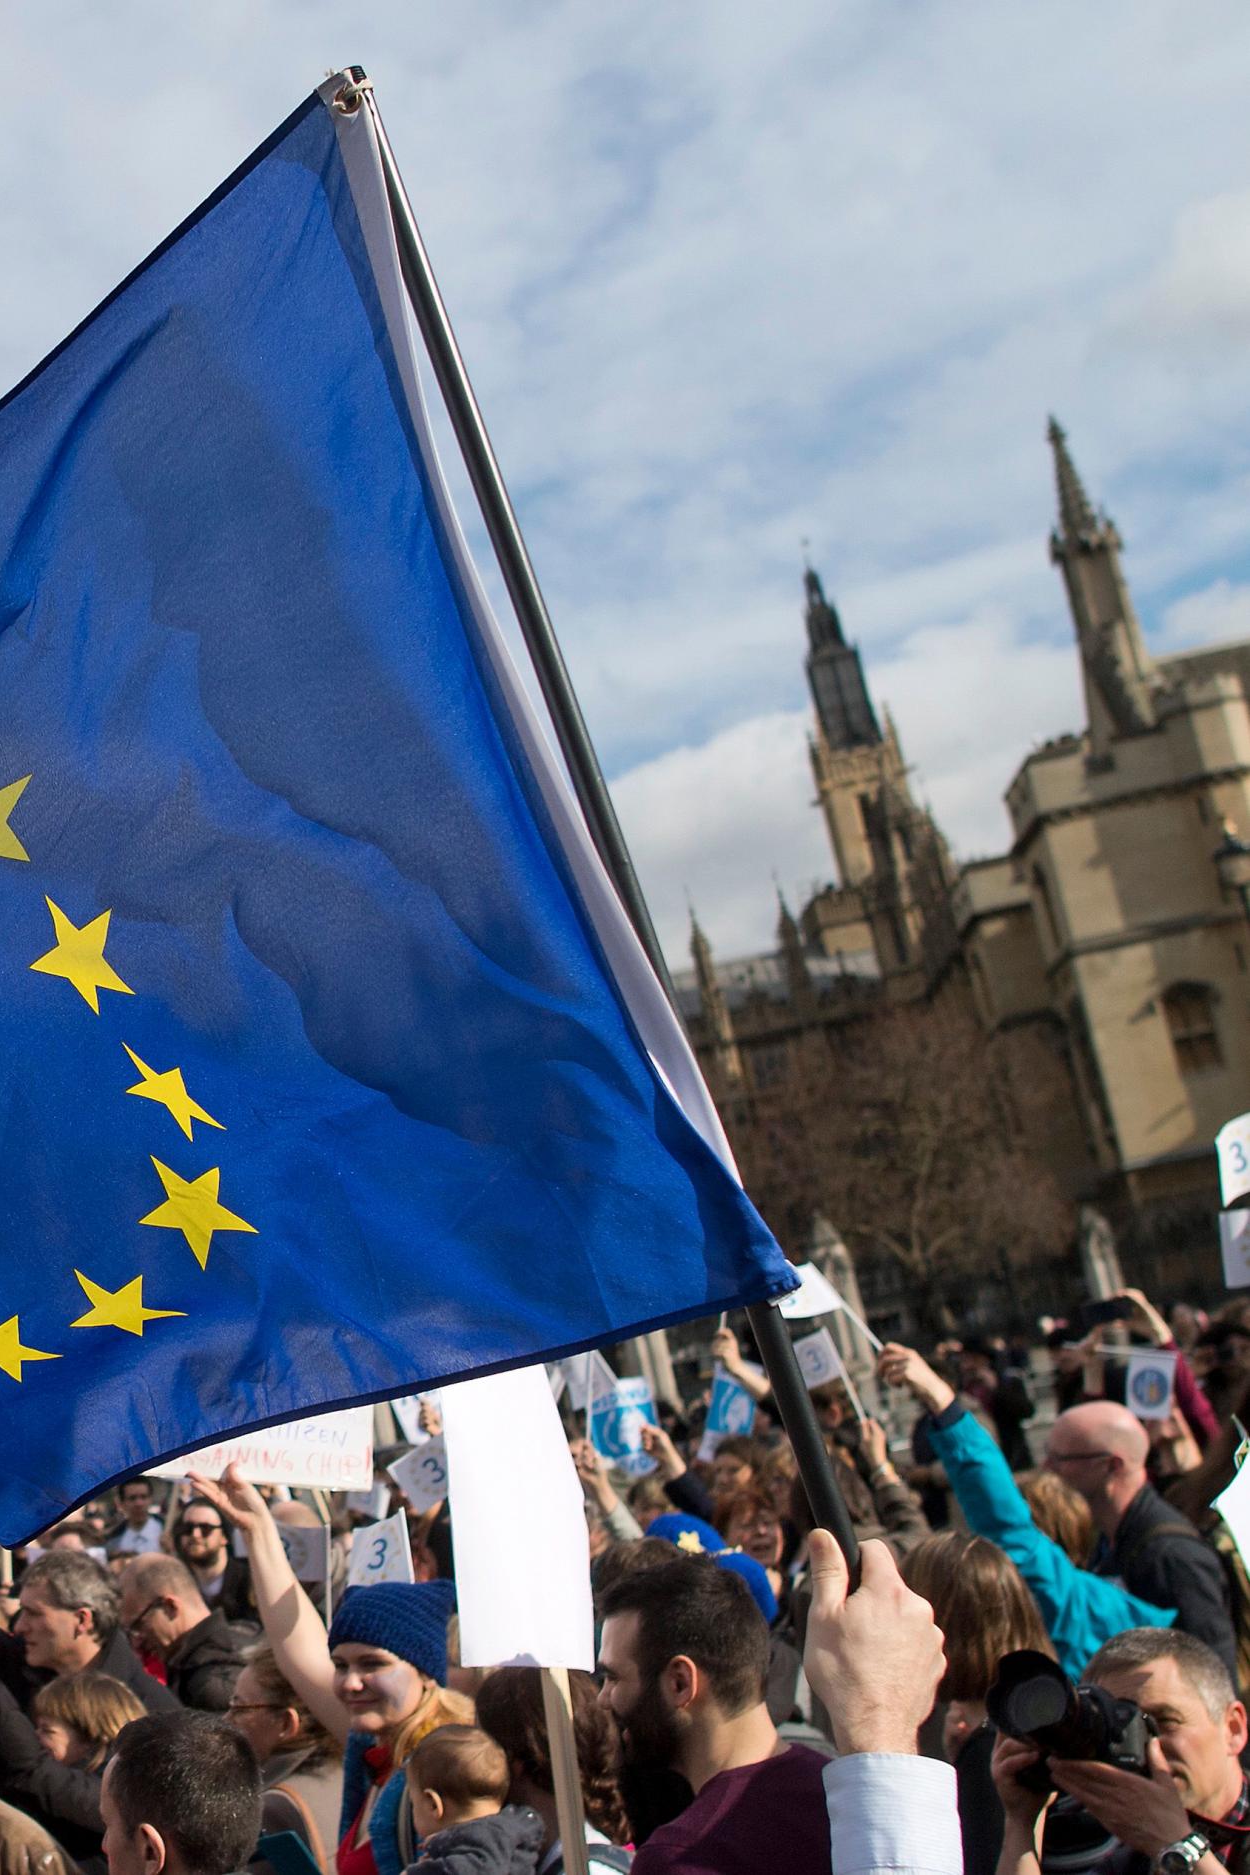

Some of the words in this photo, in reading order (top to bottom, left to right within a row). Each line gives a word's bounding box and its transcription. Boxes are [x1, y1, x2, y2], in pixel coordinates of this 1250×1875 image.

[1229, 1141, 1248, 1174] 3
[422, 1457, 446, 1484] 3
[366, 1538, 388, 1570] 3
